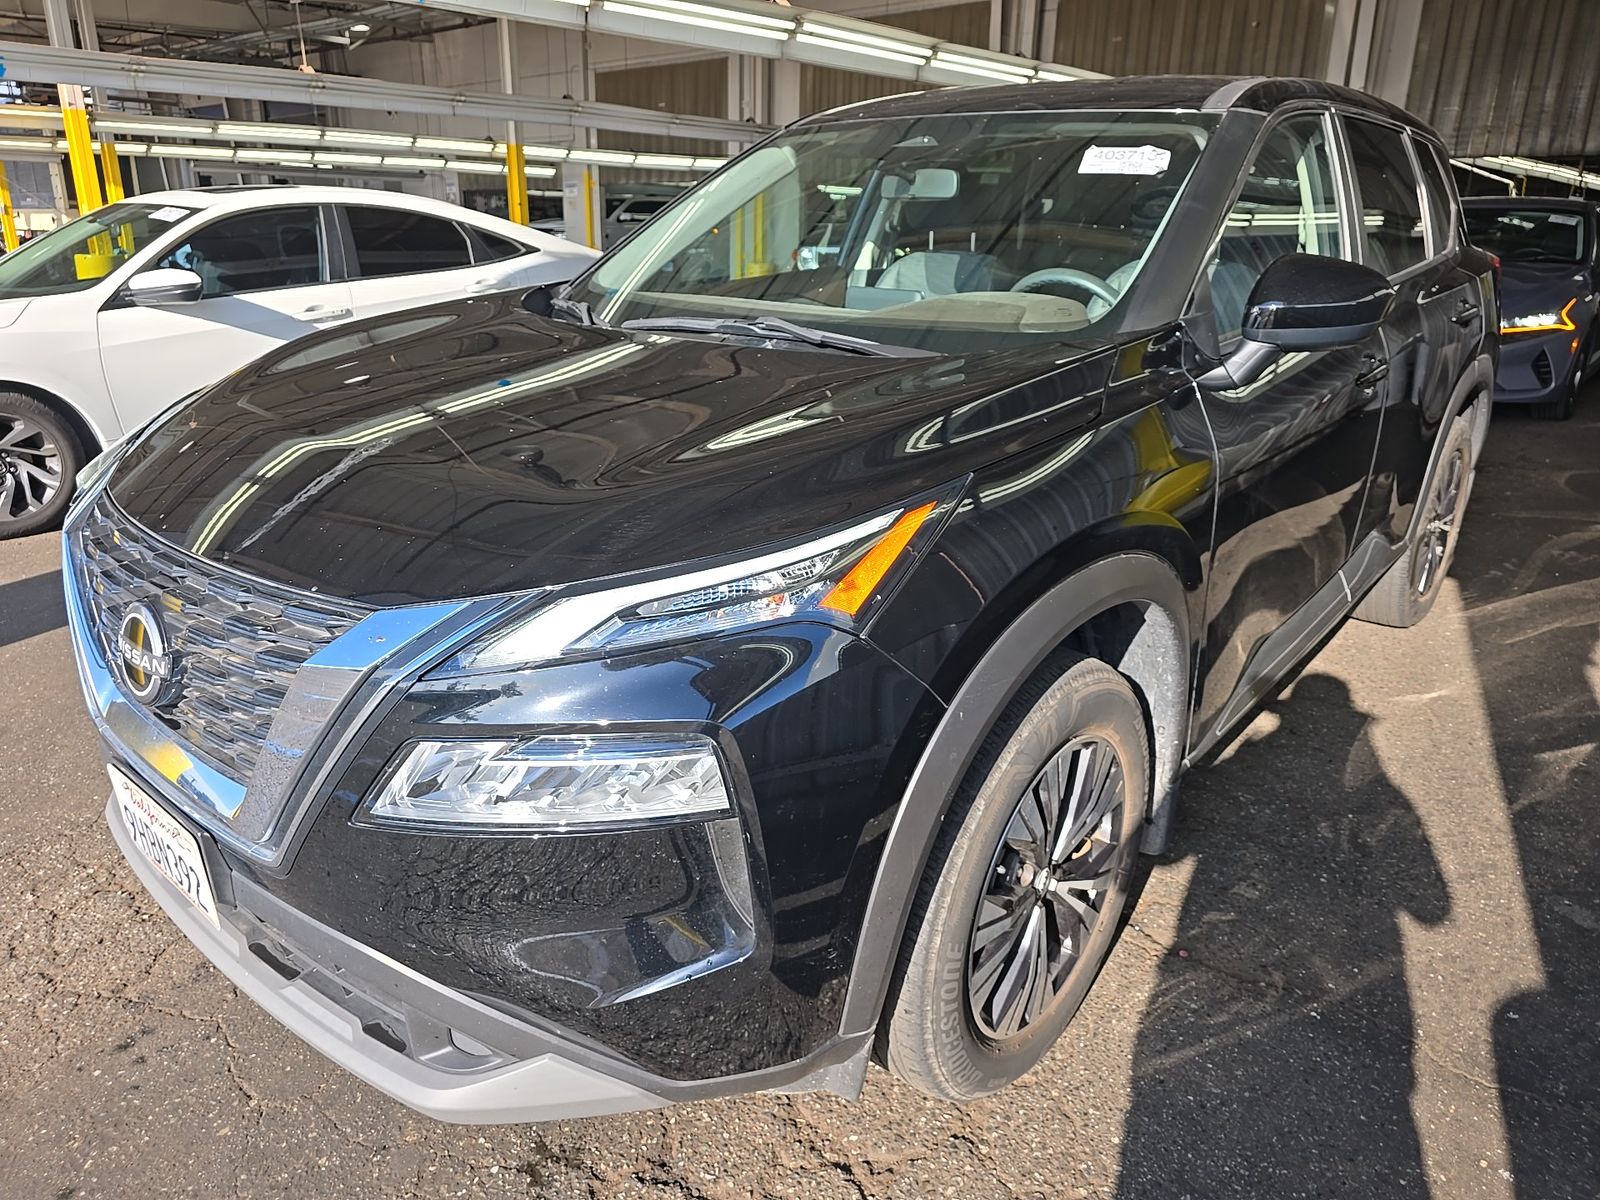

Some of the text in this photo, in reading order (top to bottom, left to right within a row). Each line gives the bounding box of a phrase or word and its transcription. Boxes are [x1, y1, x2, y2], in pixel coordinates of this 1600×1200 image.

[118, 633, 165, 676] NISSAN
[124, 804, 209, 913] 9HBN392
[941, 941, 984, 1089] BRIDGESTONE
